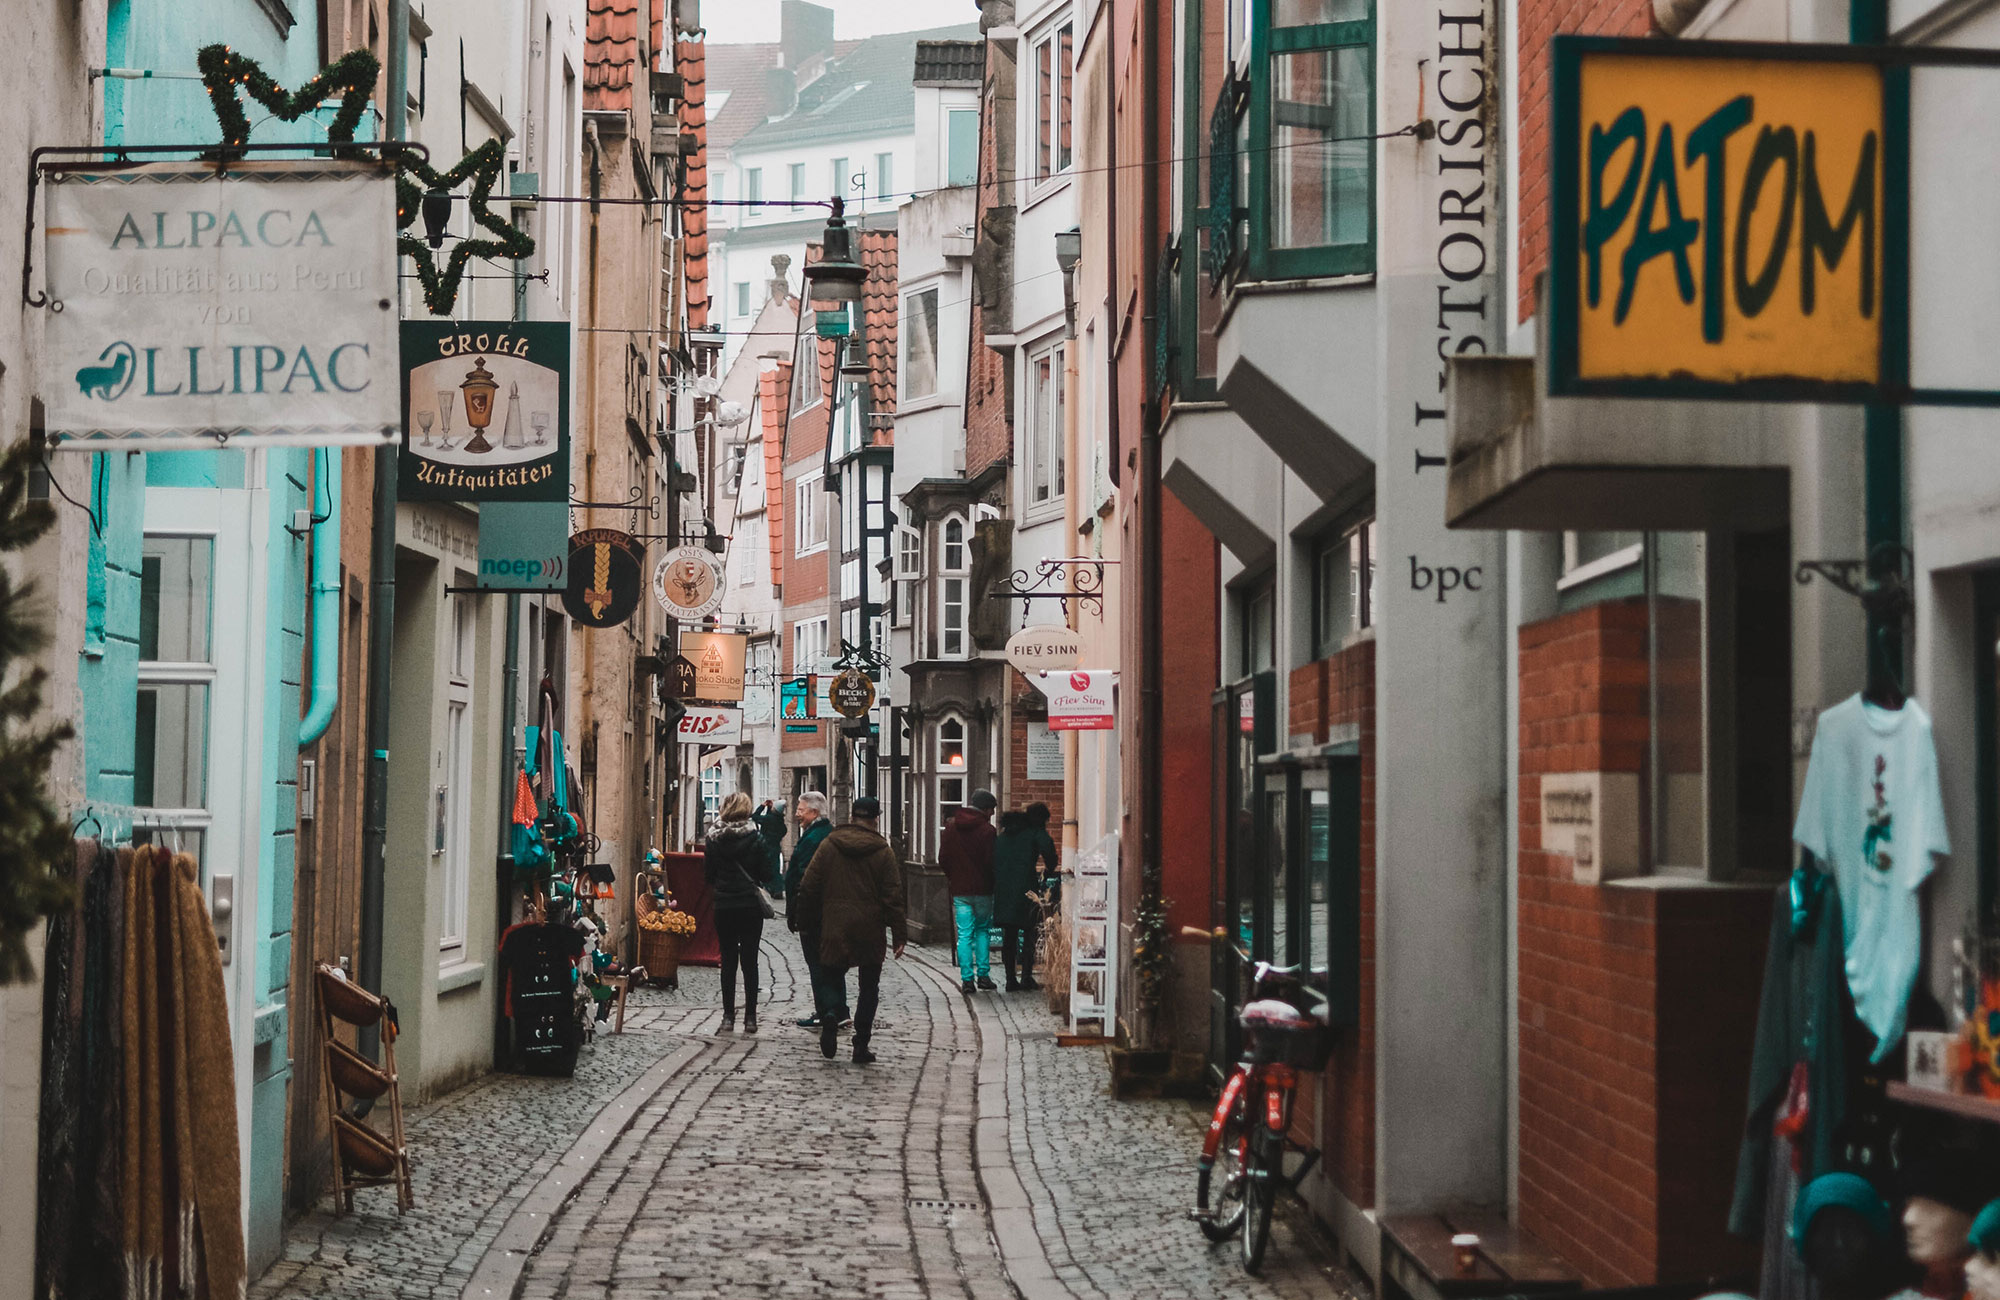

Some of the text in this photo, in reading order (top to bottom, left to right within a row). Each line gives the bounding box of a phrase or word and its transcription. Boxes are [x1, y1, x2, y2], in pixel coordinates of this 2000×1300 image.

[109, 209, 334, 250] ALPACA
[1580, 94, 1877, 344] PATOM
[80, 263, 365, 295] Qualität aus Peru
[198, 304, 252, 325] von
[438, 333, 529, 357] TROLL
[416, 461, 552, 491] Antiquitäten
[572, 529, 631, 549] RAPUNZEL
[481, 558, 543, 582] noep
[1409, 555, 1483, 603] bpc
[1014, 645, 1078, 656] FIEV SINN
[715, 675, 741, 685] Stube
[1054, 694, 1106, 706] Fiev Sinn
[679, 716, 713, 734] EIS
